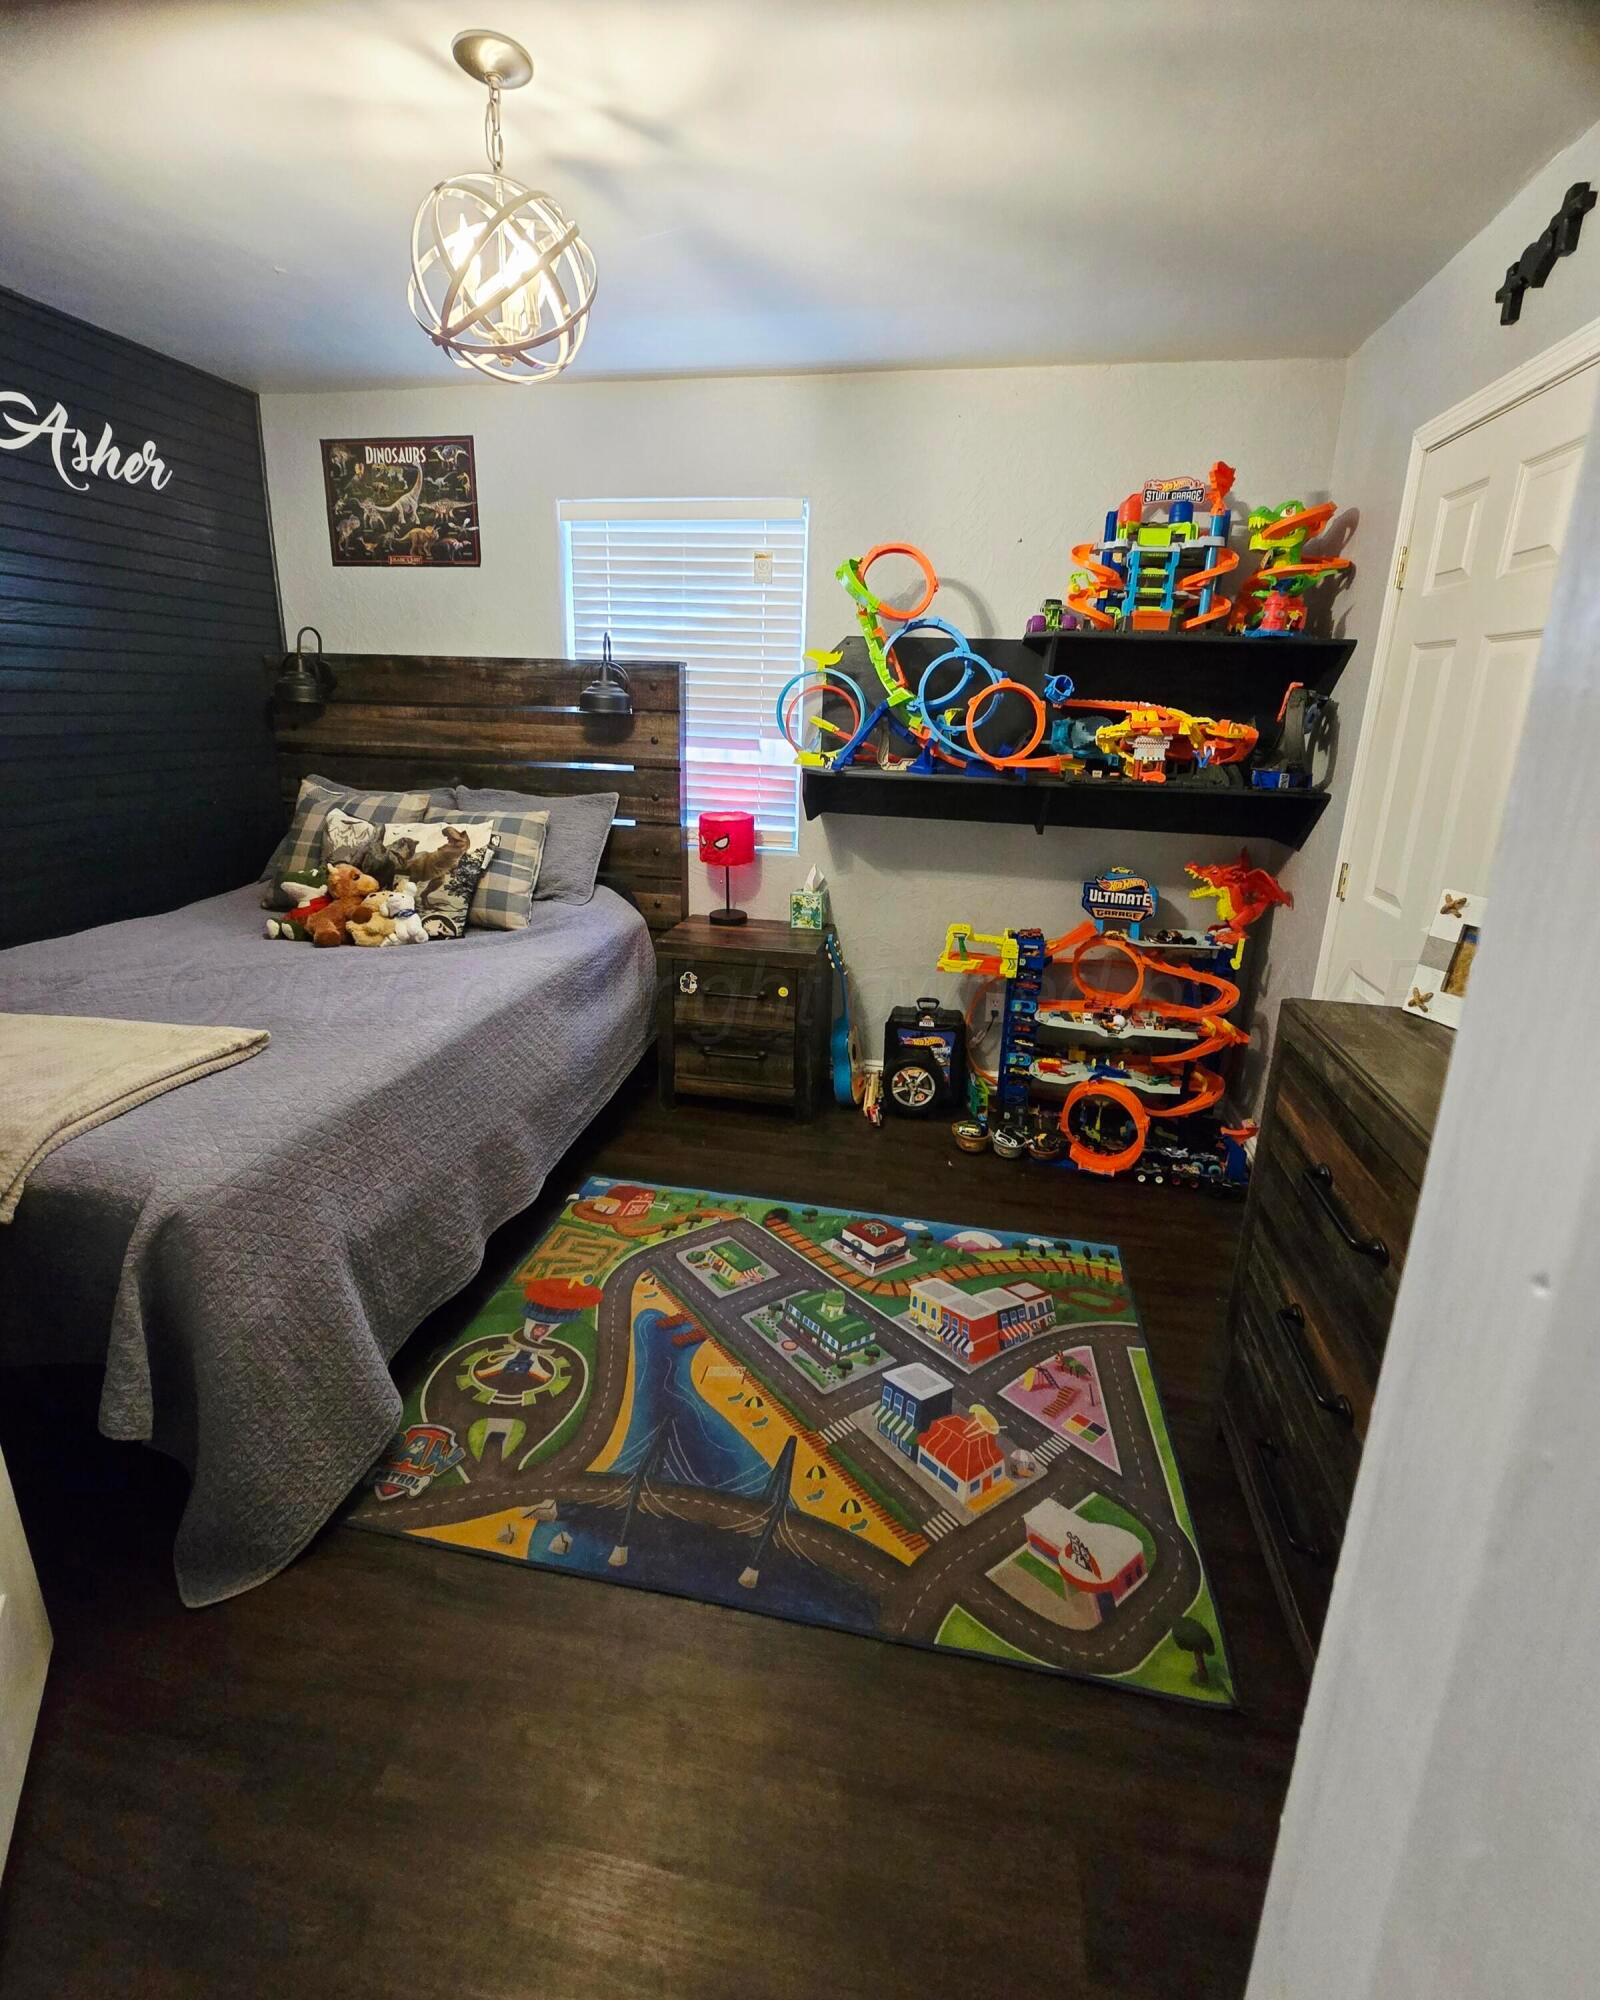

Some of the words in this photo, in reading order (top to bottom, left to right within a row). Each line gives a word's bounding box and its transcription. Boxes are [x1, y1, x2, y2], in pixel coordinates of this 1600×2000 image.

[0, 391, 173, 491] Asher
[364, 445, 427, 465] DINOSAURS
[1145, 490, 1170, 502] STUNT
[1171, 490, 1203, 502] GARAGE
[1089, 888, 1152, 906] ULTIMATE
[1095, 909, 1142, 919] GARAGE
